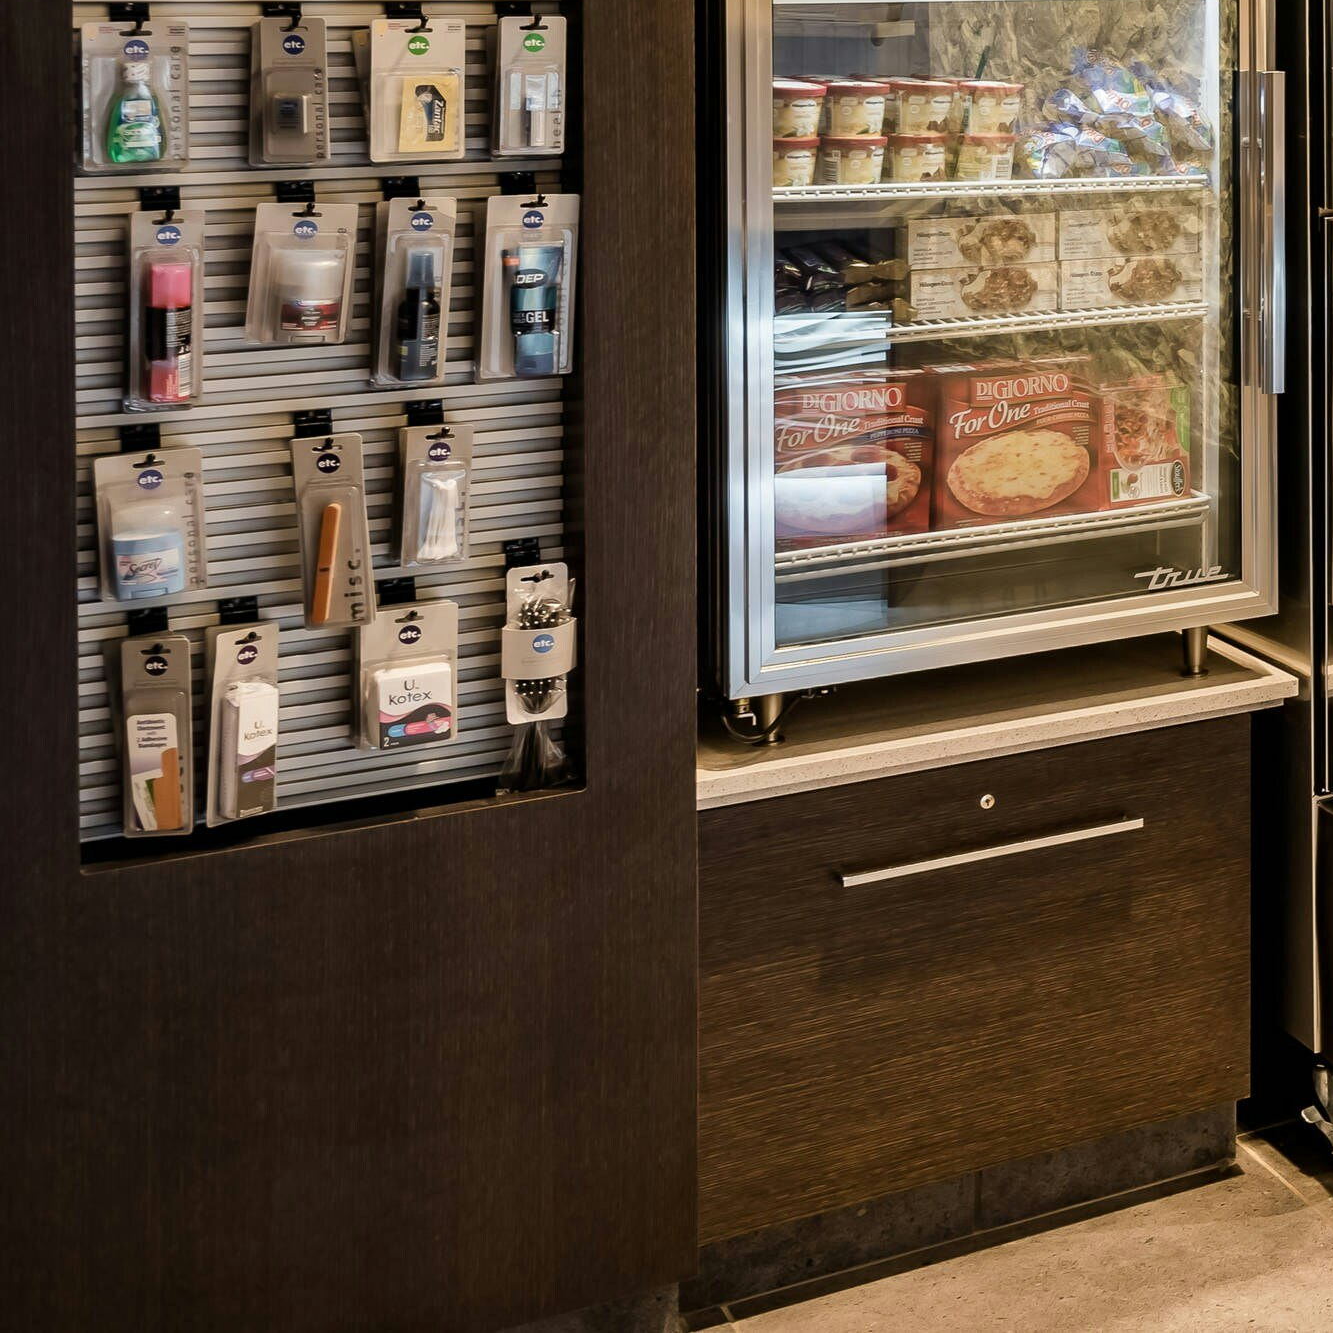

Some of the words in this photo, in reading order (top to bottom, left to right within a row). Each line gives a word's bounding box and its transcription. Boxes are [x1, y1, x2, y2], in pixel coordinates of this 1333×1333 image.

[170, 45, 182, 81] care
[168, 89, 181, 161] personal
[316, 101, 327, 159] personal
[515, 273, 545, 284] DEP
[526, 311, 549, 324] GEL
[776, 423, 812, 452] For
[814, 413, 861, 442] One
[950, 408, 987, 440] For
[987, 400, 1032, 429] One
[1071, 399, 1090, 409] Crust
[344, 548, 365, 621] misc.
